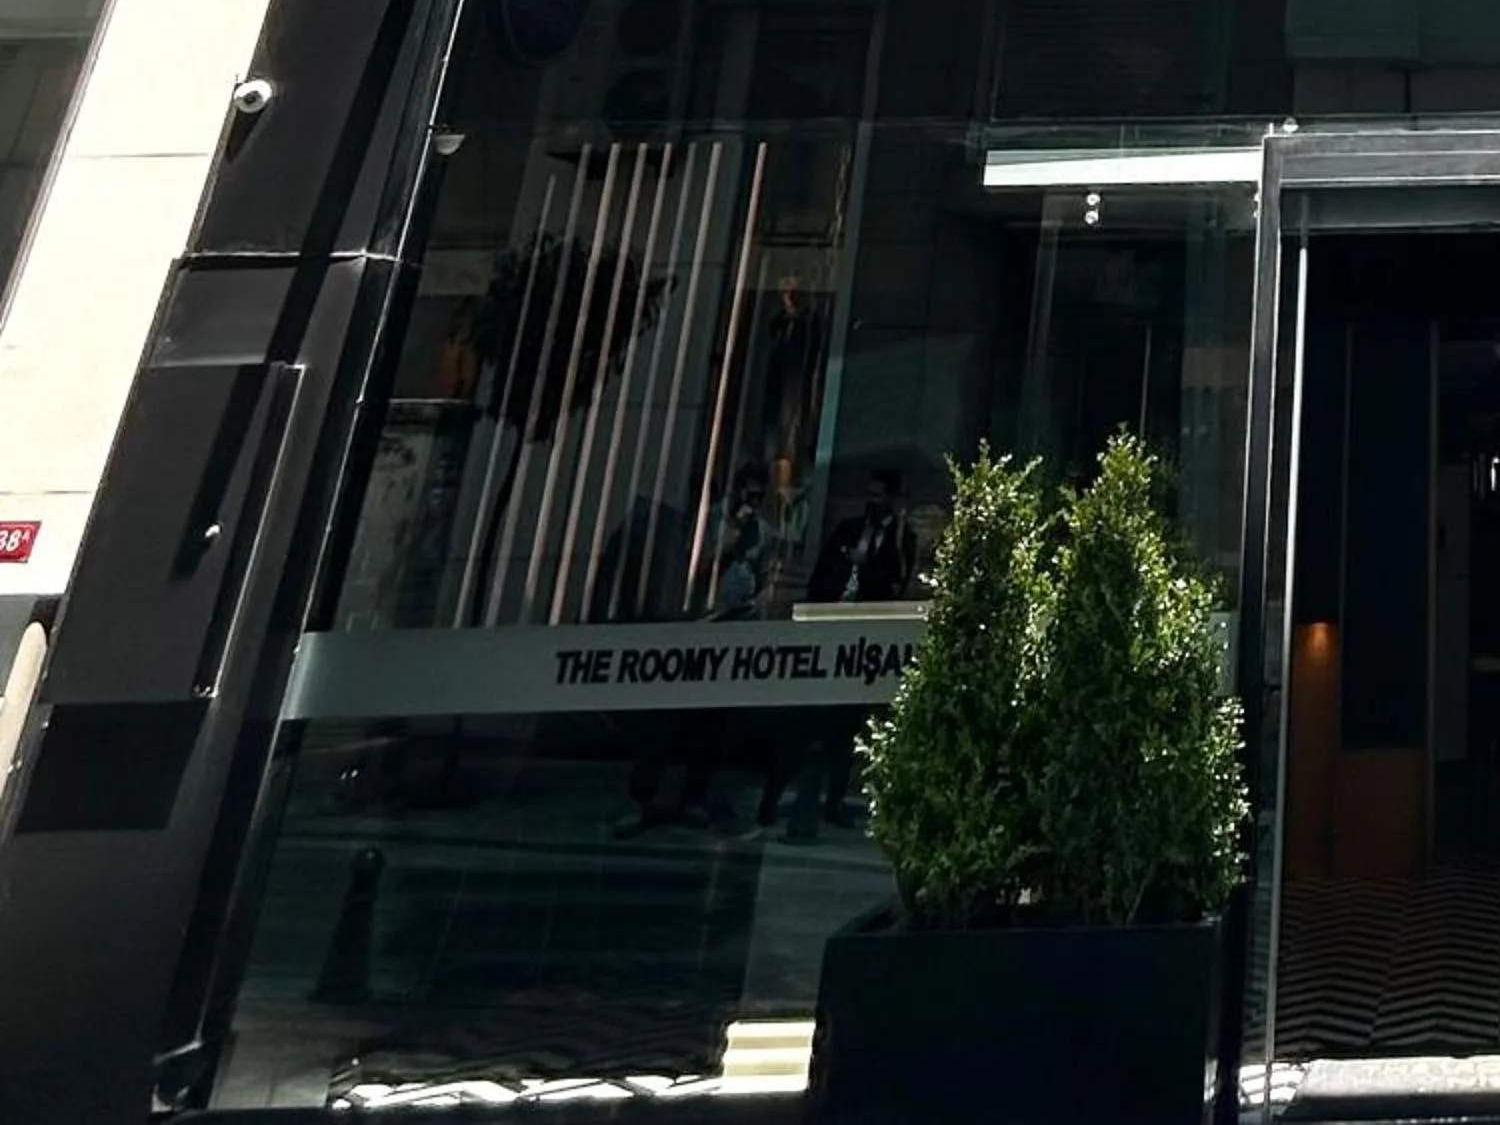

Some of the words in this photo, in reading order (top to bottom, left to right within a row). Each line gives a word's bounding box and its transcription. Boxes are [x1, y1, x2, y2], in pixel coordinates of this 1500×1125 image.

[555, 648, 613, 685] THE
[616, 645, 730, 683] ROOMY
[729, 643, 827, 680] HOTEL
